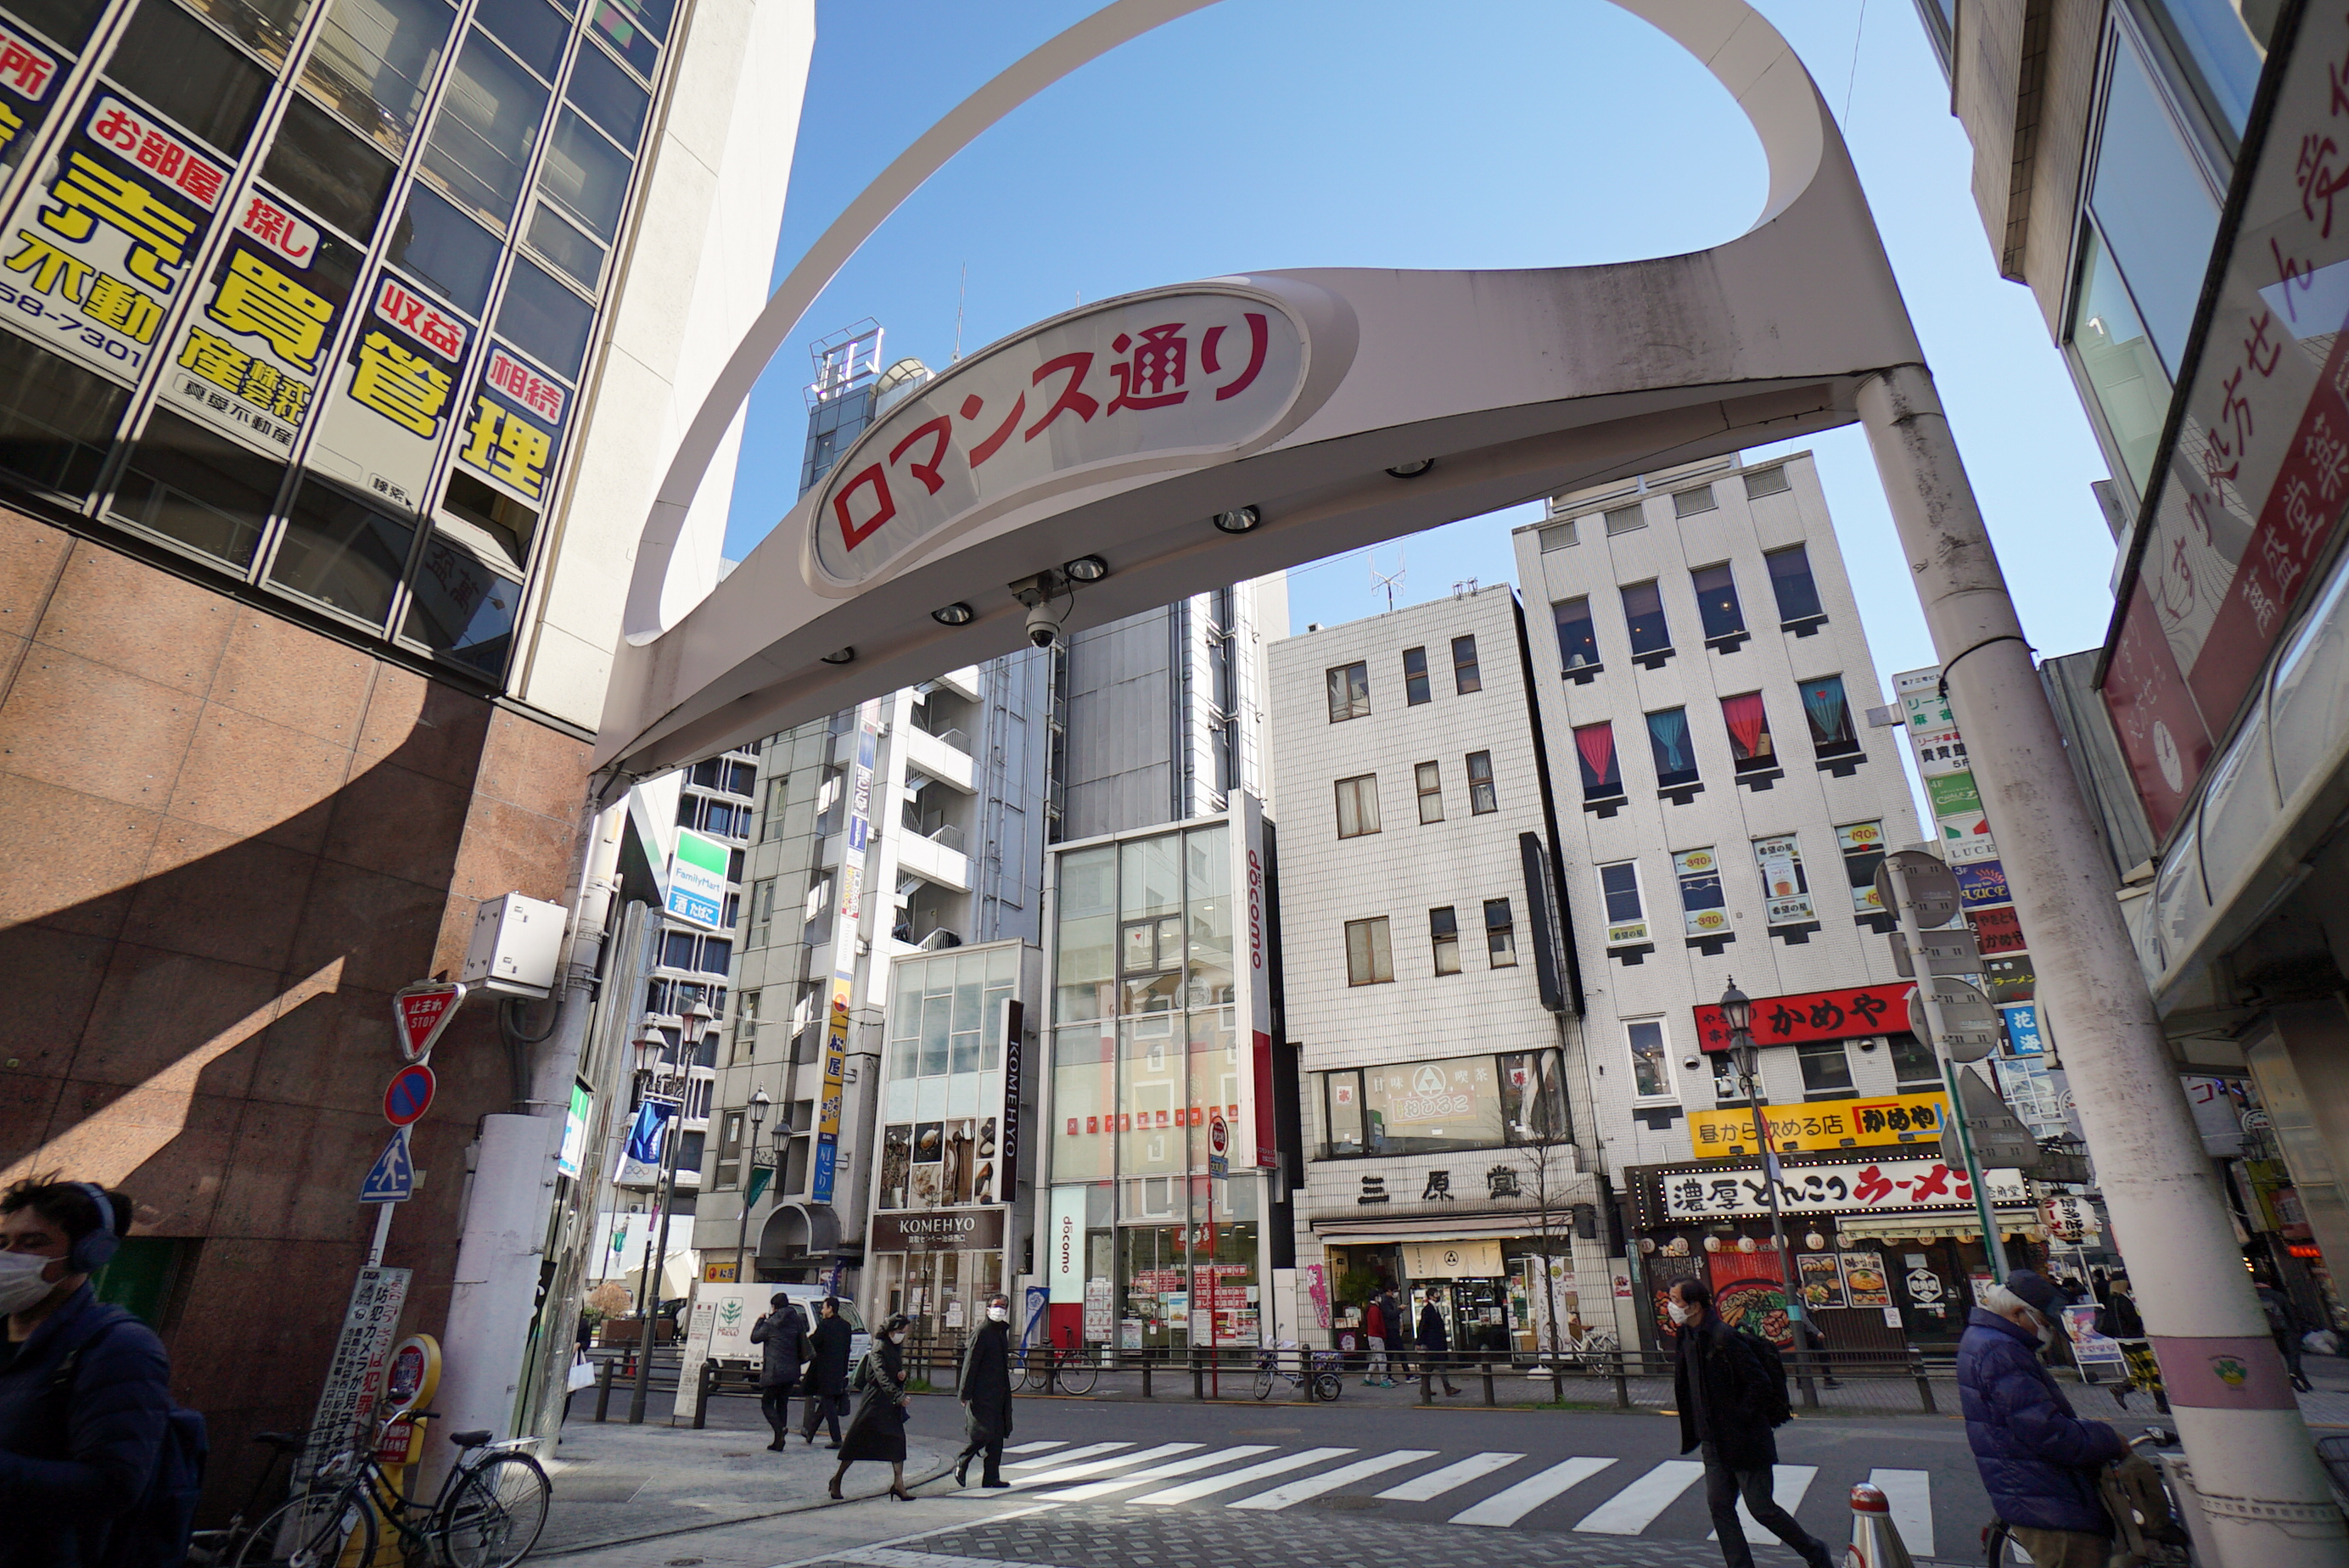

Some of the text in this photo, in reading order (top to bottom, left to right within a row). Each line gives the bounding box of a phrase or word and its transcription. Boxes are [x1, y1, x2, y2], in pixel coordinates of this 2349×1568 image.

[380, 283, 463, 357] 収益
[490, 353, 567, 421] 相続
[833, 313, 1269, 552] ロマンス通り
[1953, 758, 1970, 768] 5F
[1931, 780, 1944, 789] 4F
[1951, 844, 1997, 859] LUCE
[675, 867, 721, 893] FamilyMart
[1954, 866, 1969, 876] 3F
[1960, 885, 2009, 901] LUCE
[674, 895, 714, 922] 酒 たばこ
[1248, 848, 1262, 970] docomo
[1985, 931, 2024, 949] かめや
[1993, 974, 2036, 987] ラーメン
[408, 996, 443, 1015] 止まれ
[1768, 994, 1888, 1037] かめや
[411, 1016, 436, 1028] STOP
[828, 1033, 844, 1077] 松屋
[1455, 1067, 1488, 1084] 喫茶
[1005, 1040, 1019, 1158] KOMEHYO
[1862, 1106, 1936, 1134] かめや
[1358, 1165, 1521, 1205] 三原堂
[900, 1217, 976, 1234] KOMEHYO
[1062, 1216, 1073, 1274] docomo
